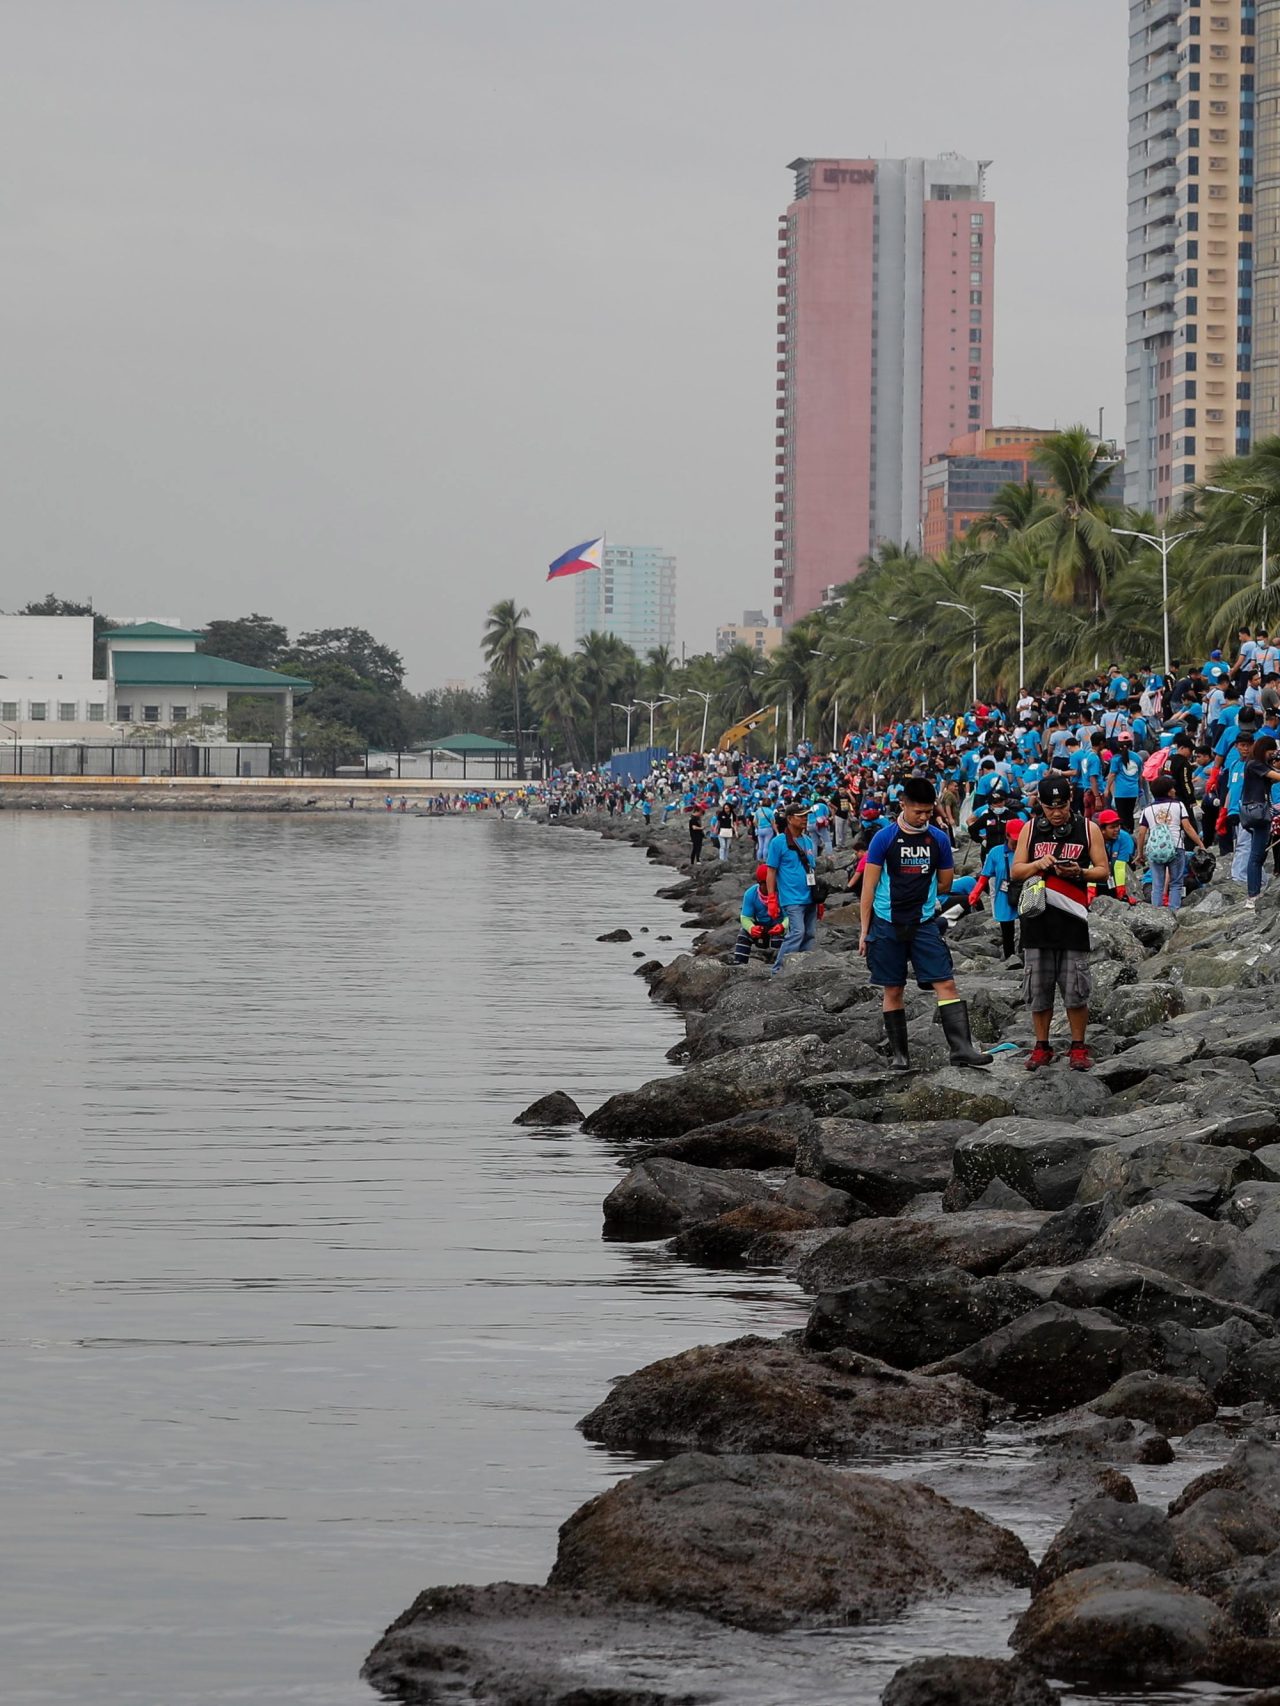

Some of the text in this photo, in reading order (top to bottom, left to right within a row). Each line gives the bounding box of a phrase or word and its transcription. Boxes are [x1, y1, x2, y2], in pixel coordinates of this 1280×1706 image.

[900, 846, 931, 858] RUN
[900, 857, 931, 865] united
[921, 864, 929, 874] 2
